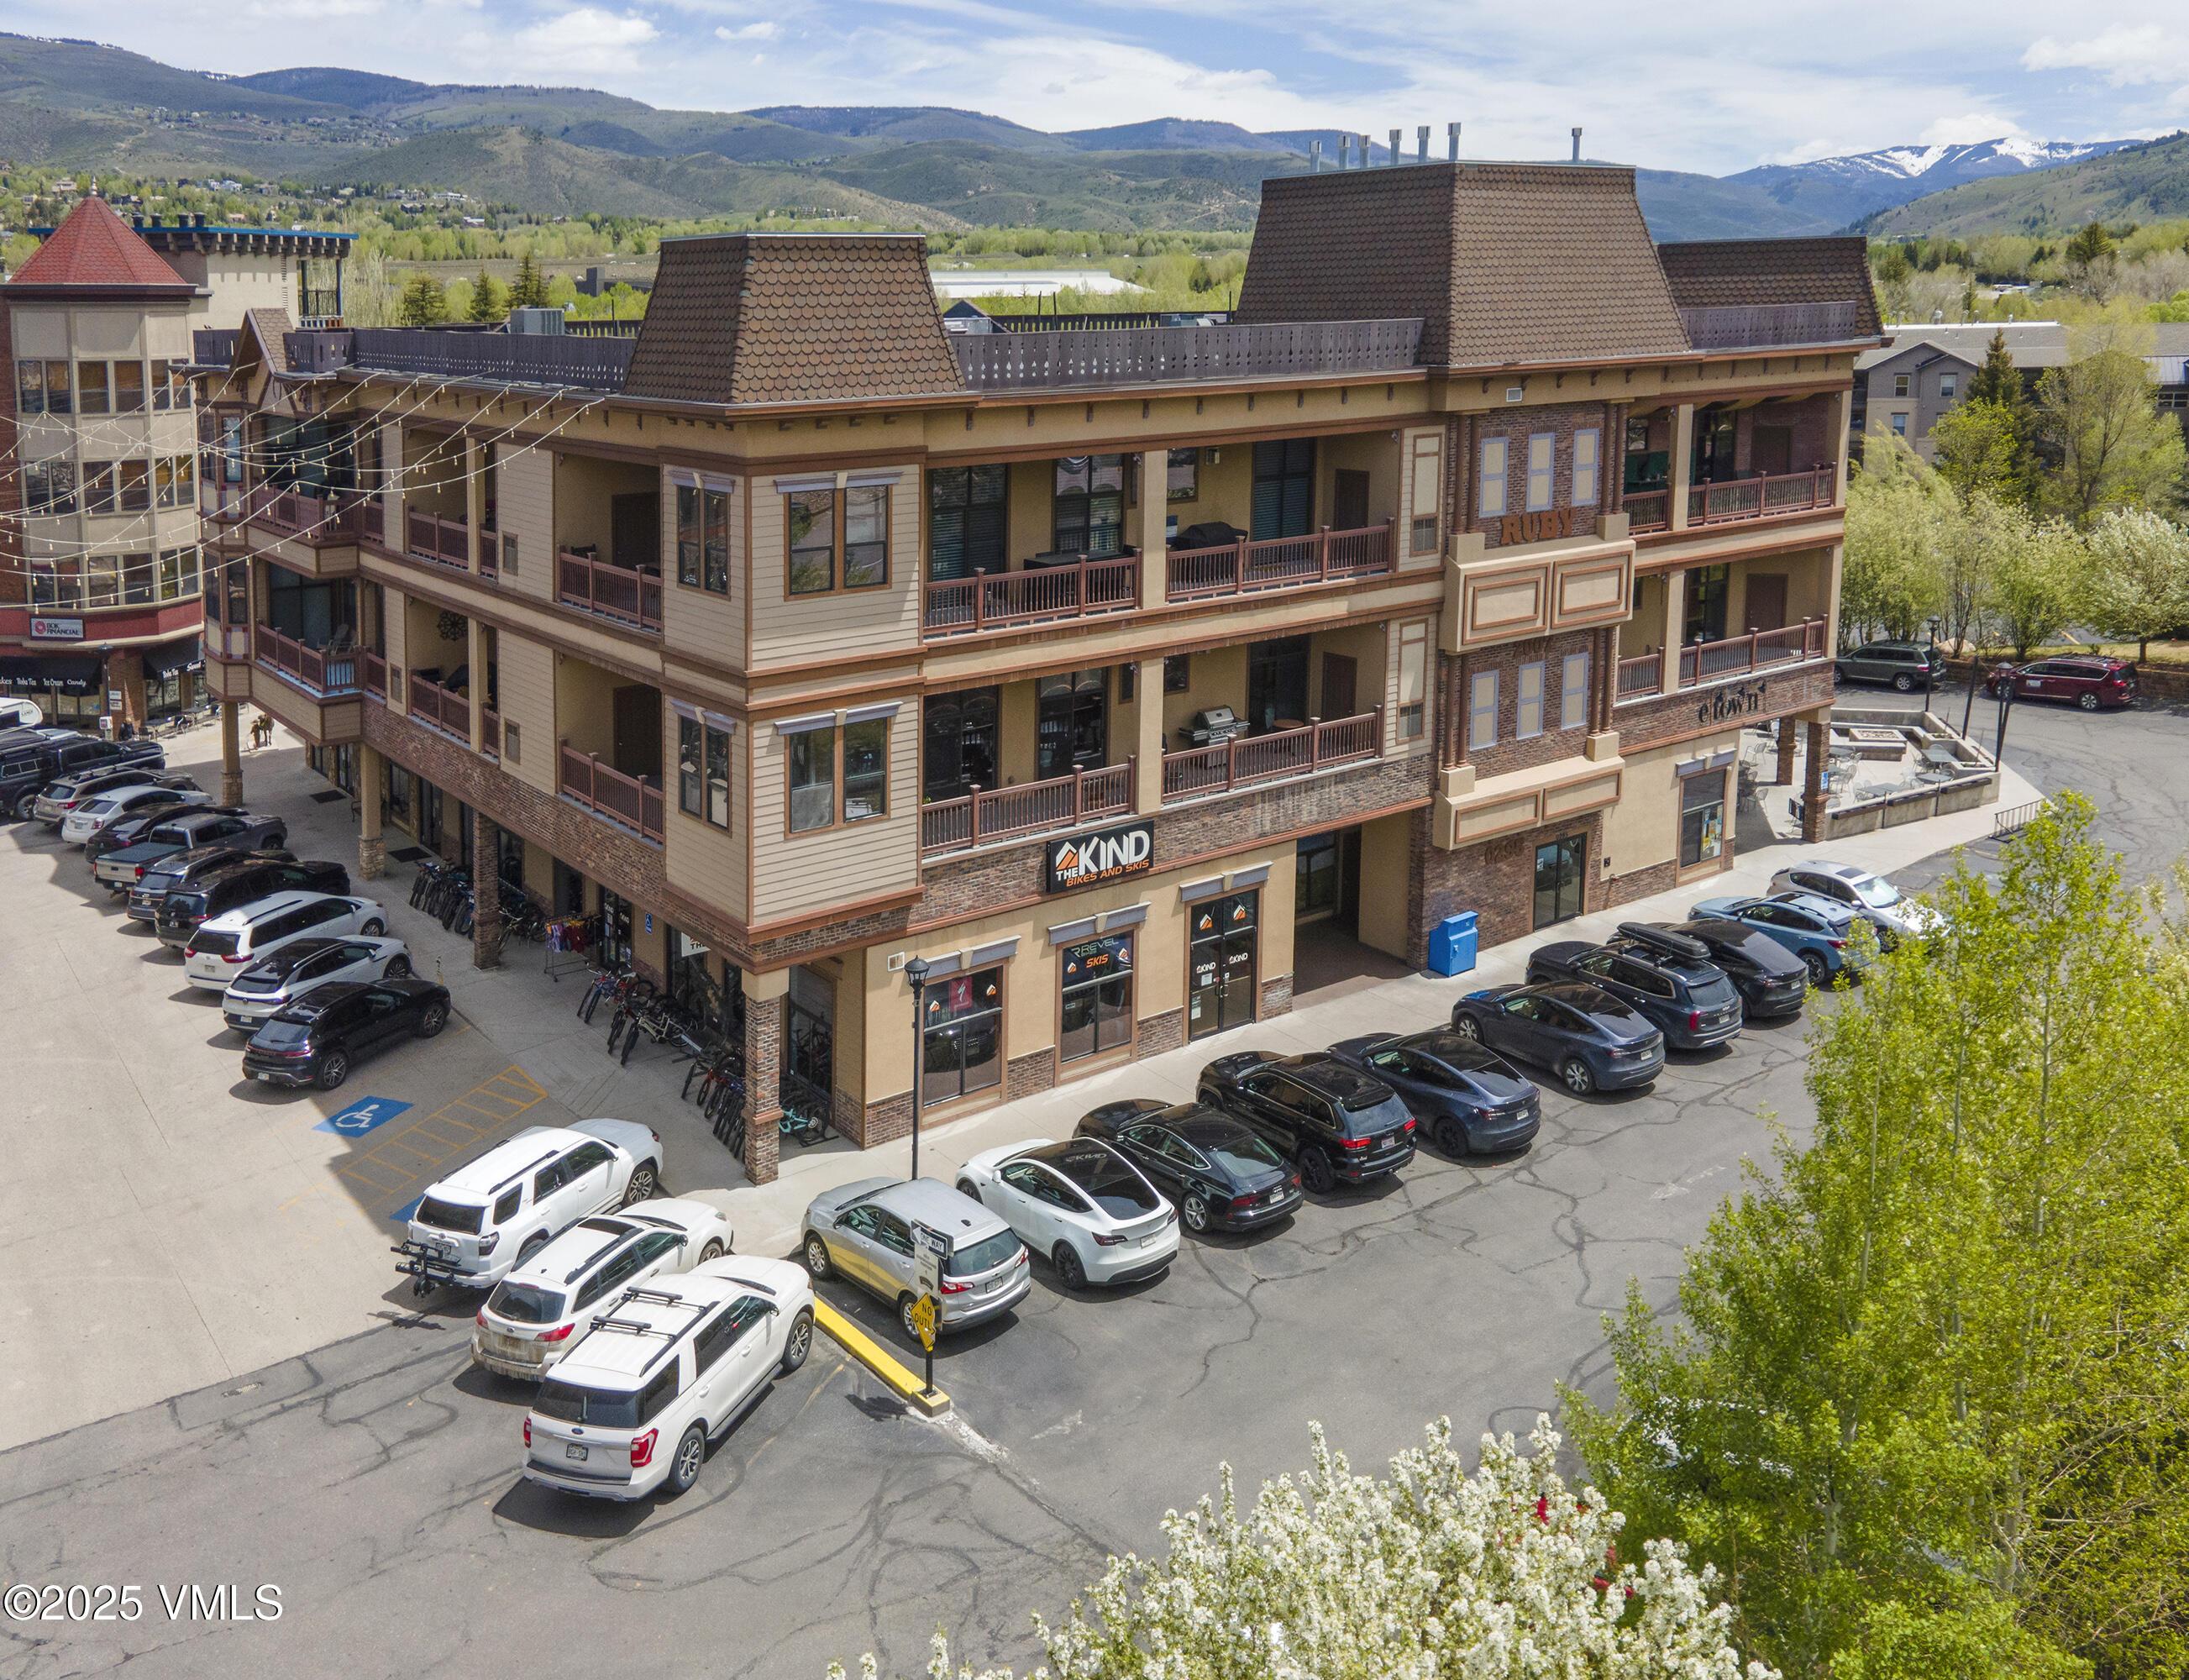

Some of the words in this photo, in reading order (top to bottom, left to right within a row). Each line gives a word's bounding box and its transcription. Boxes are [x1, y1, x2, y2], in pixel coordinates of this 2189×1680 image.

[1500, 507, 1577, 546] RUBY
[67, 679, 87, 687] Candy
[1078, 830, 1150, 876] KIND
[1056, 867, 1079, 881] THE
[1066, 871, 1098, 888] BIKES
[1100, 866, 1123, 879] AND
[1126, 858, 1150, 873] SKIS
[690, 942, 706, 950] TH
[1086, 953, 1109, 969] SKIS
[1233, 953, 1248, 963] KIND
[1201, 962, 1216, 972] KIND
[921, 1231, 929, 1244] ONE
[931, 1238, 942, 1251] WAY
[921, 1302, 932, 1316] NO
[914, 1313, 932, 1331] OUTL
